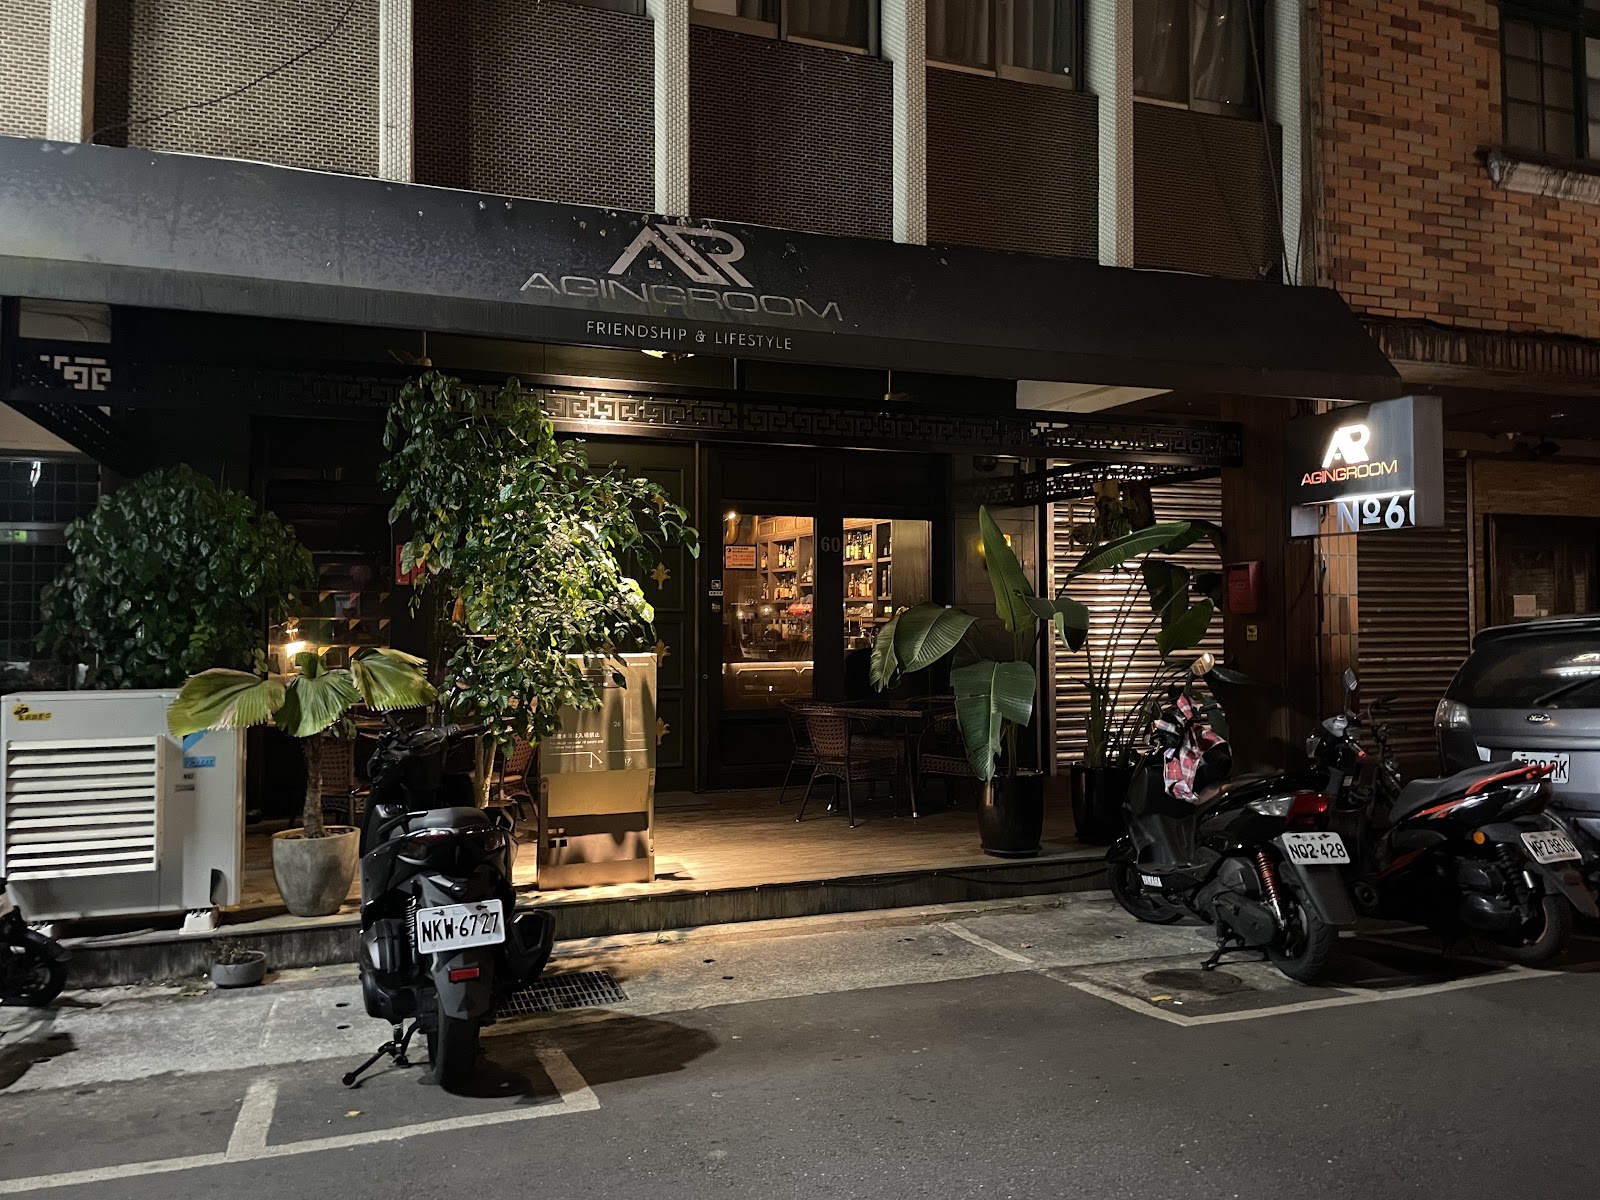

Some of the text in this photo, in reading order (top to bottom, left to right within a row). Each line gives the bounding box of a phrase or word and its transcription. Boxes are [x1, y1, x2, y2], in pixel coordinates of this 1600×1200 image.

[520, 272, 843, 321] AGINGROOM
[586, 321, 792, 350] FRIENDSHIP & LIFESTYLE
[1301, 460, 1398, 486] AGINGROOM
[820, 536, 841, 553] 60
